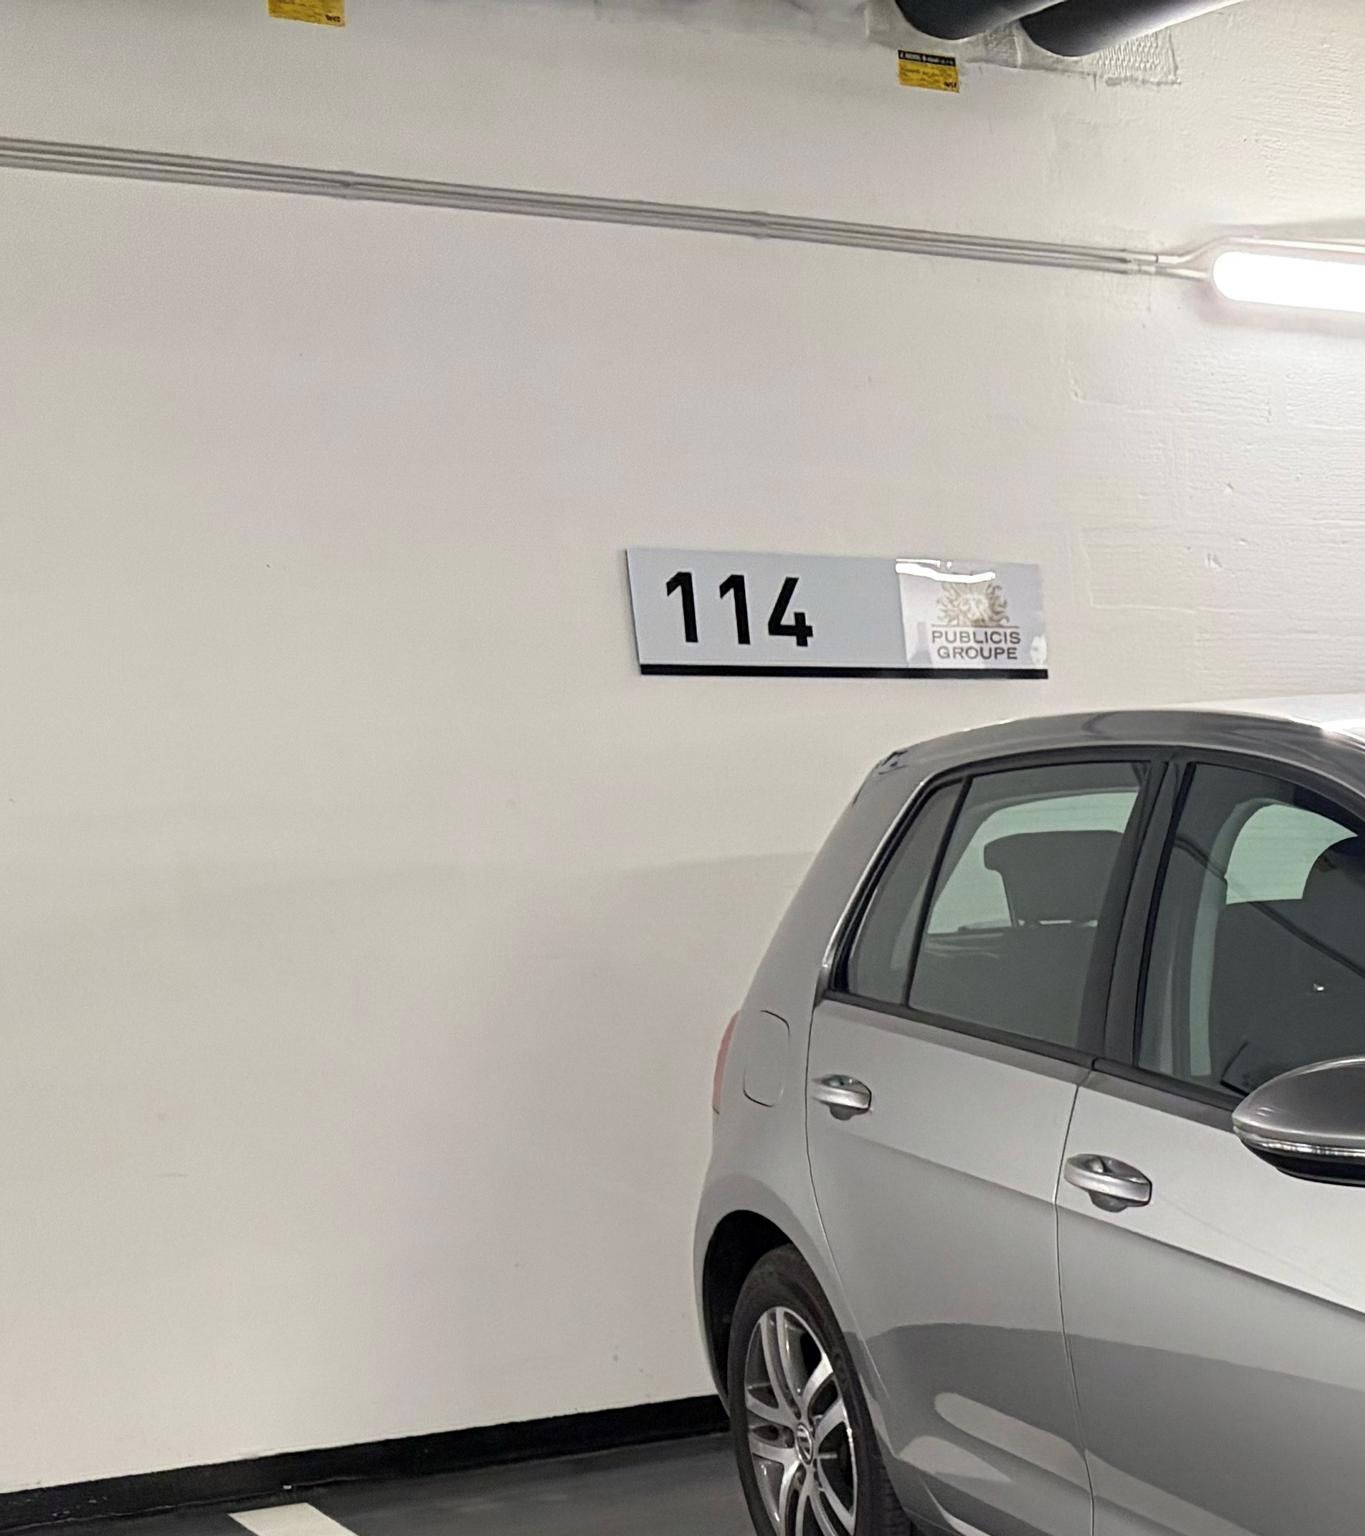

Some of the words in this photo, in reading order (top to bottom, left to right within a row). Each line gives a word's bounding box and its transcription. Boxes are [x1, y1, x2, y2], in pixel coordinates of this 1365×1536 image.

[666, 571, 813, 646] 114
[931, 630, 1021, 646] PUBLICIS
[937, 645, 1018, 660] GROUPE
